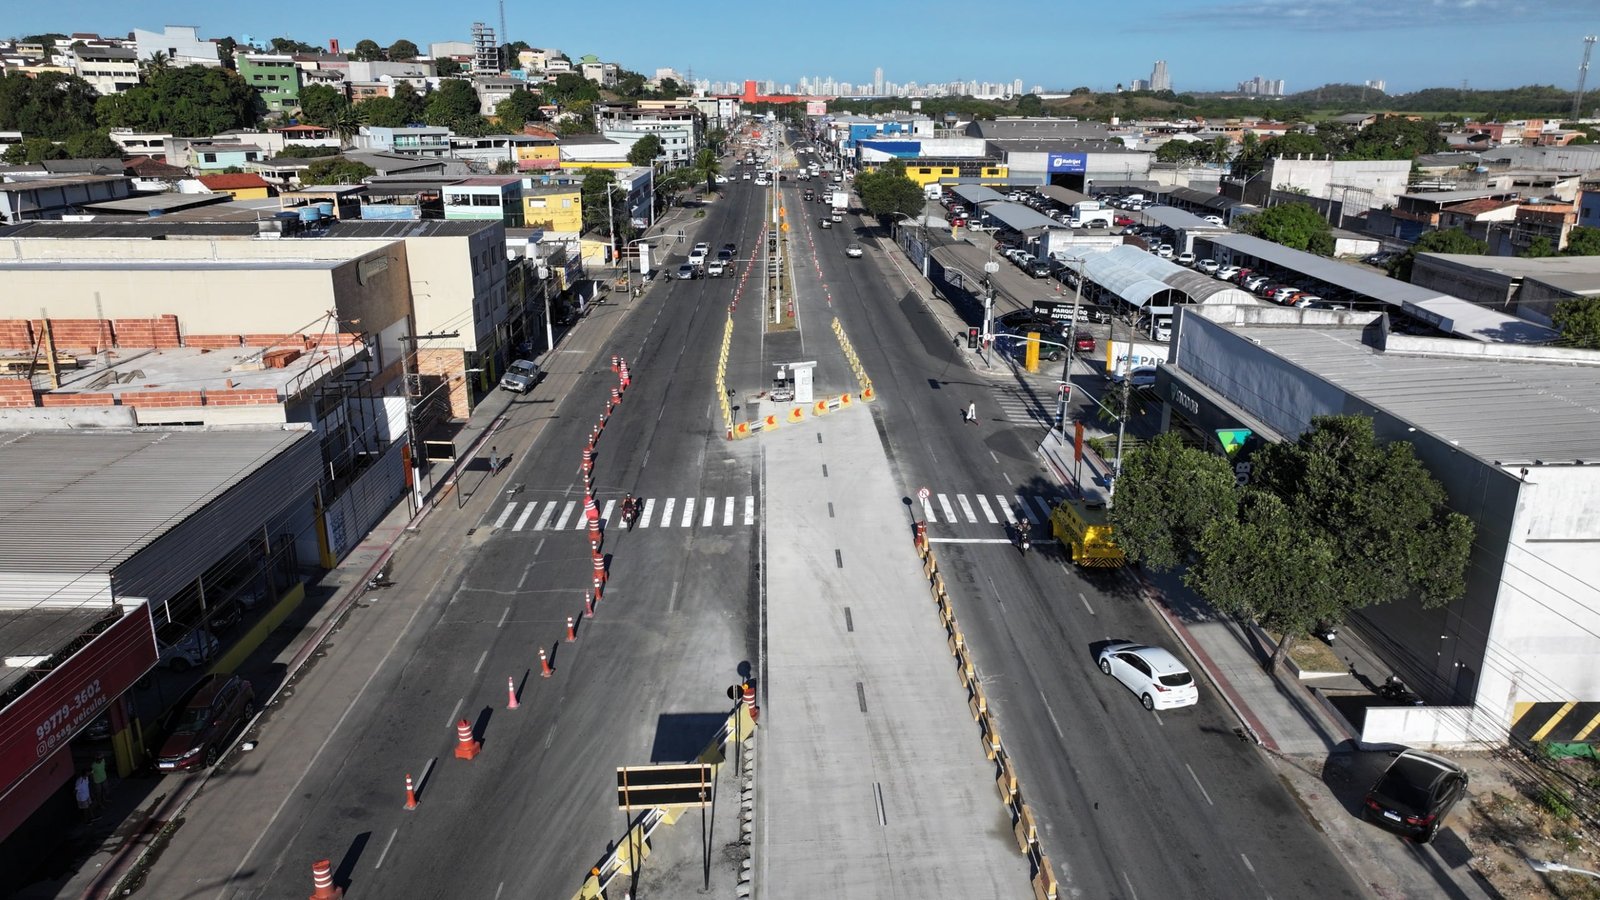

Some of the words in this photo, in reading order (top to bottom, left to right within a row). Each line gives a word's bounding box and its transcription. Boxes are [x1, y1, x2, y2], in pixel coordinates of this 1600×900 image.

[1052, 307, 1076, 315] PARQU
[1051, 313, 1089, 321] AUTOMVEL
[36, 679, 101, 741] 99779-3602
